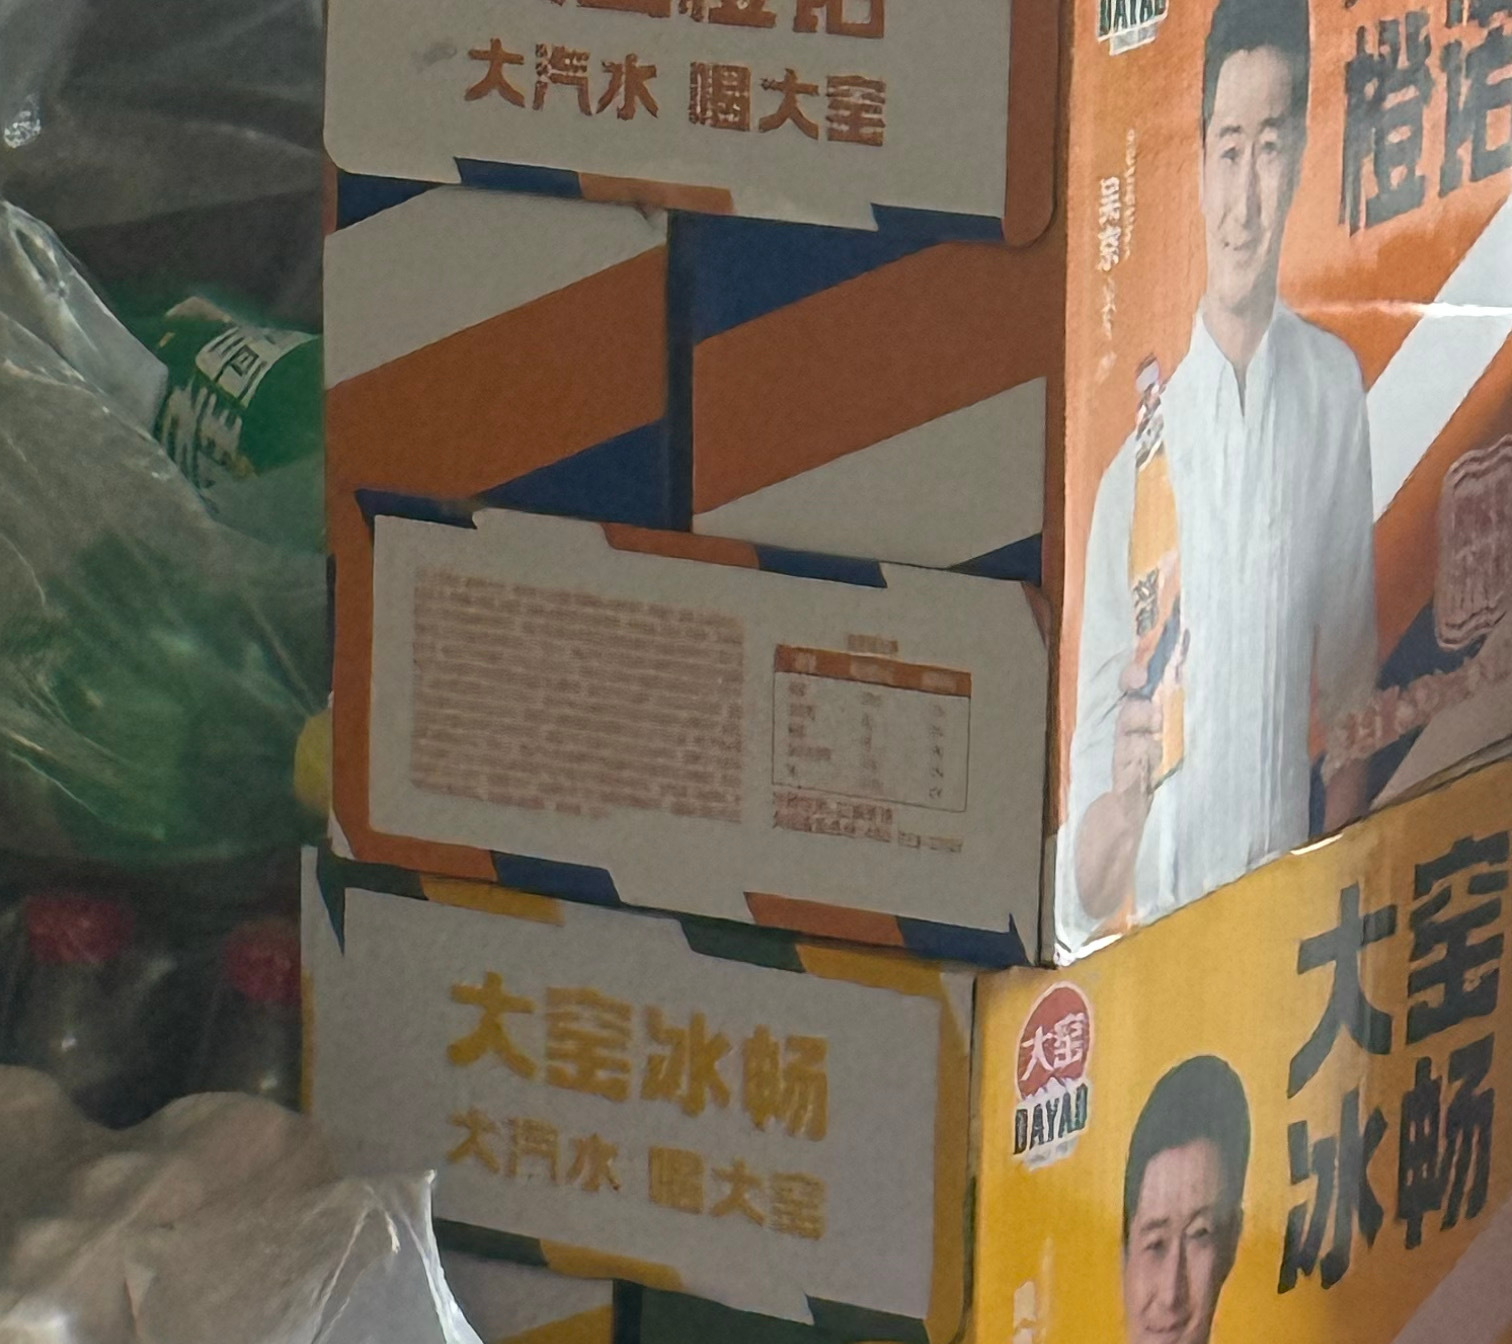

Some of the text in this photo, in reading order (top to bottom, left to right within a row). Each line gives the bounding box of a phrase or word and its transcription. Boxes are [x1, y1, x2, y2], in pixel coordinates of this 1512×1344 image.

[463, 37, 886, 147] 大汽水 喝大窑
[1287, 831, 1509, 1099] 大窑
[446, 970, 829, 1142] 大窑冰畅
[1020, 1011, 1086, 1081] 大窑
[1012, 1083, 1089, 1155] DAYAO
[1277, 1032, 1496, 1295] 冰畅
